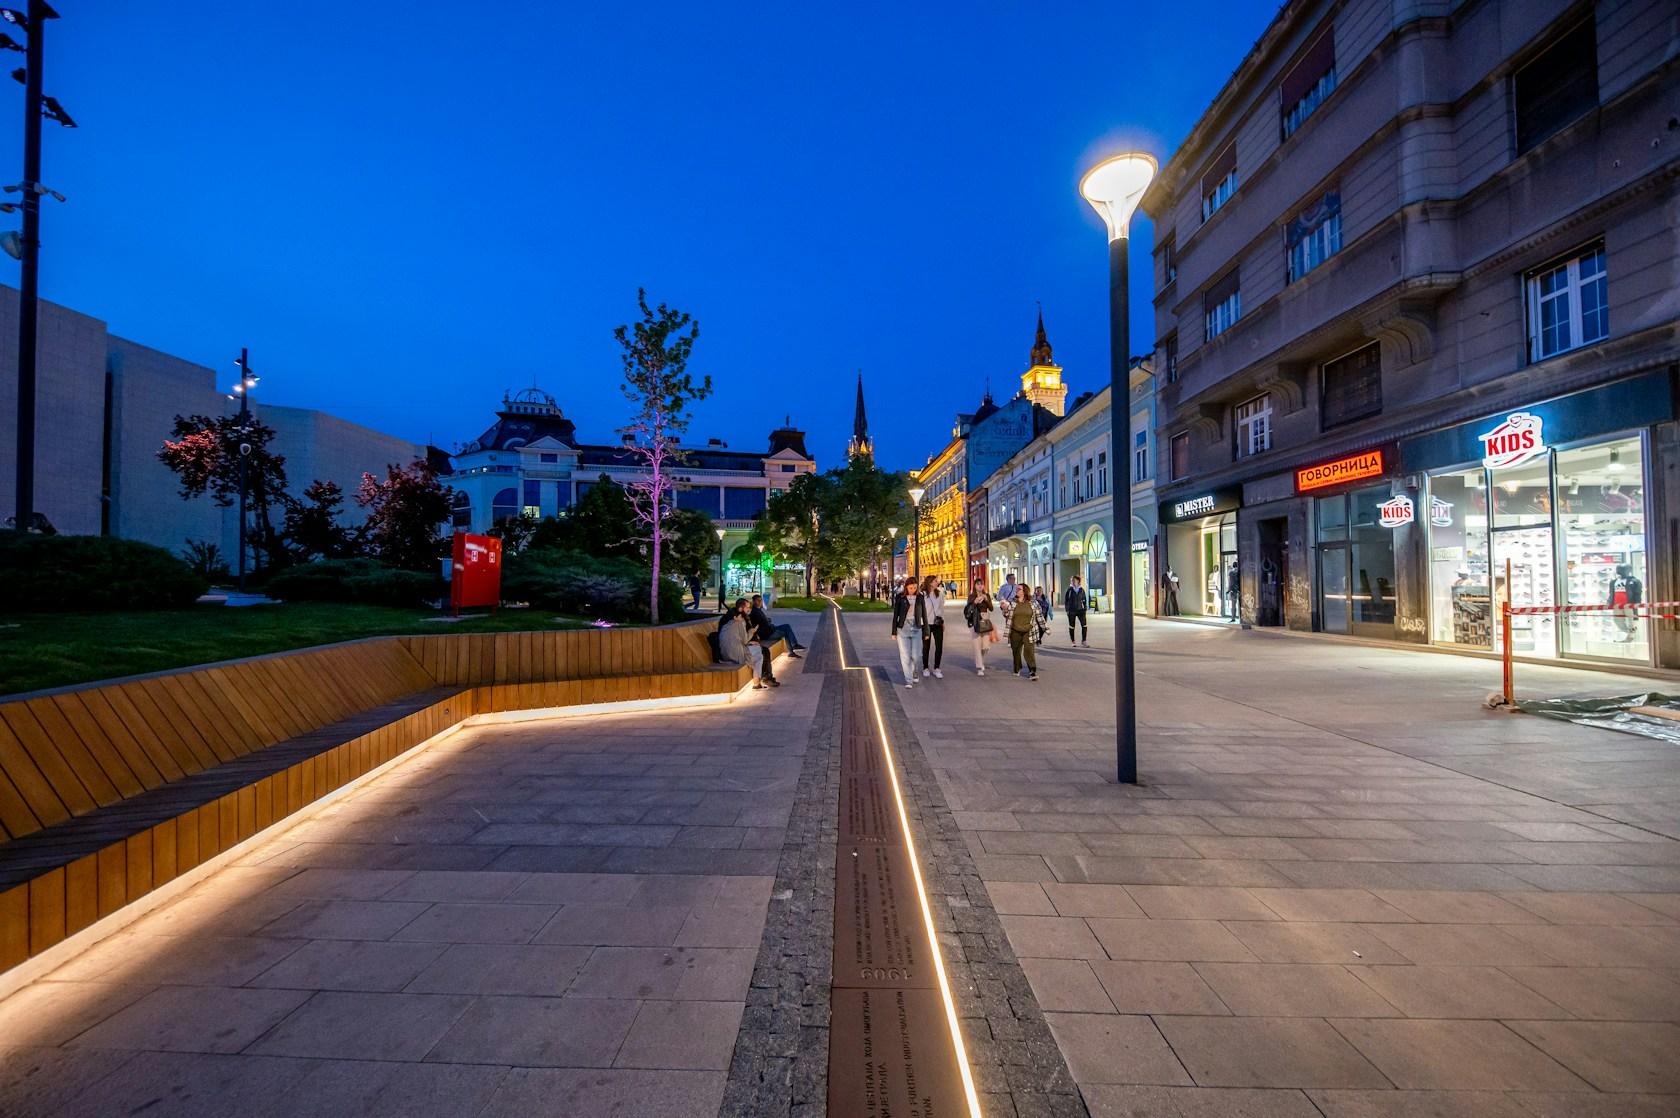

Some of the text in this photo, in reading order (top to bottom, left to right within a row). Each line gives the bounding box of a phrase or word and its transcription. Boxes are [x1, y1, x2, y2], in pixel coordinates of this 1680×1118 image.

[1487, 429, 1535, 456] KIDS
[1300, 455, 1379, 483] ГОВОРНИЦА
[1183, 495, 1215, 513] MISTER
[1383, 505, 1412, 519] KIDS
[1131, 541, 1149, 552] OTEKA
